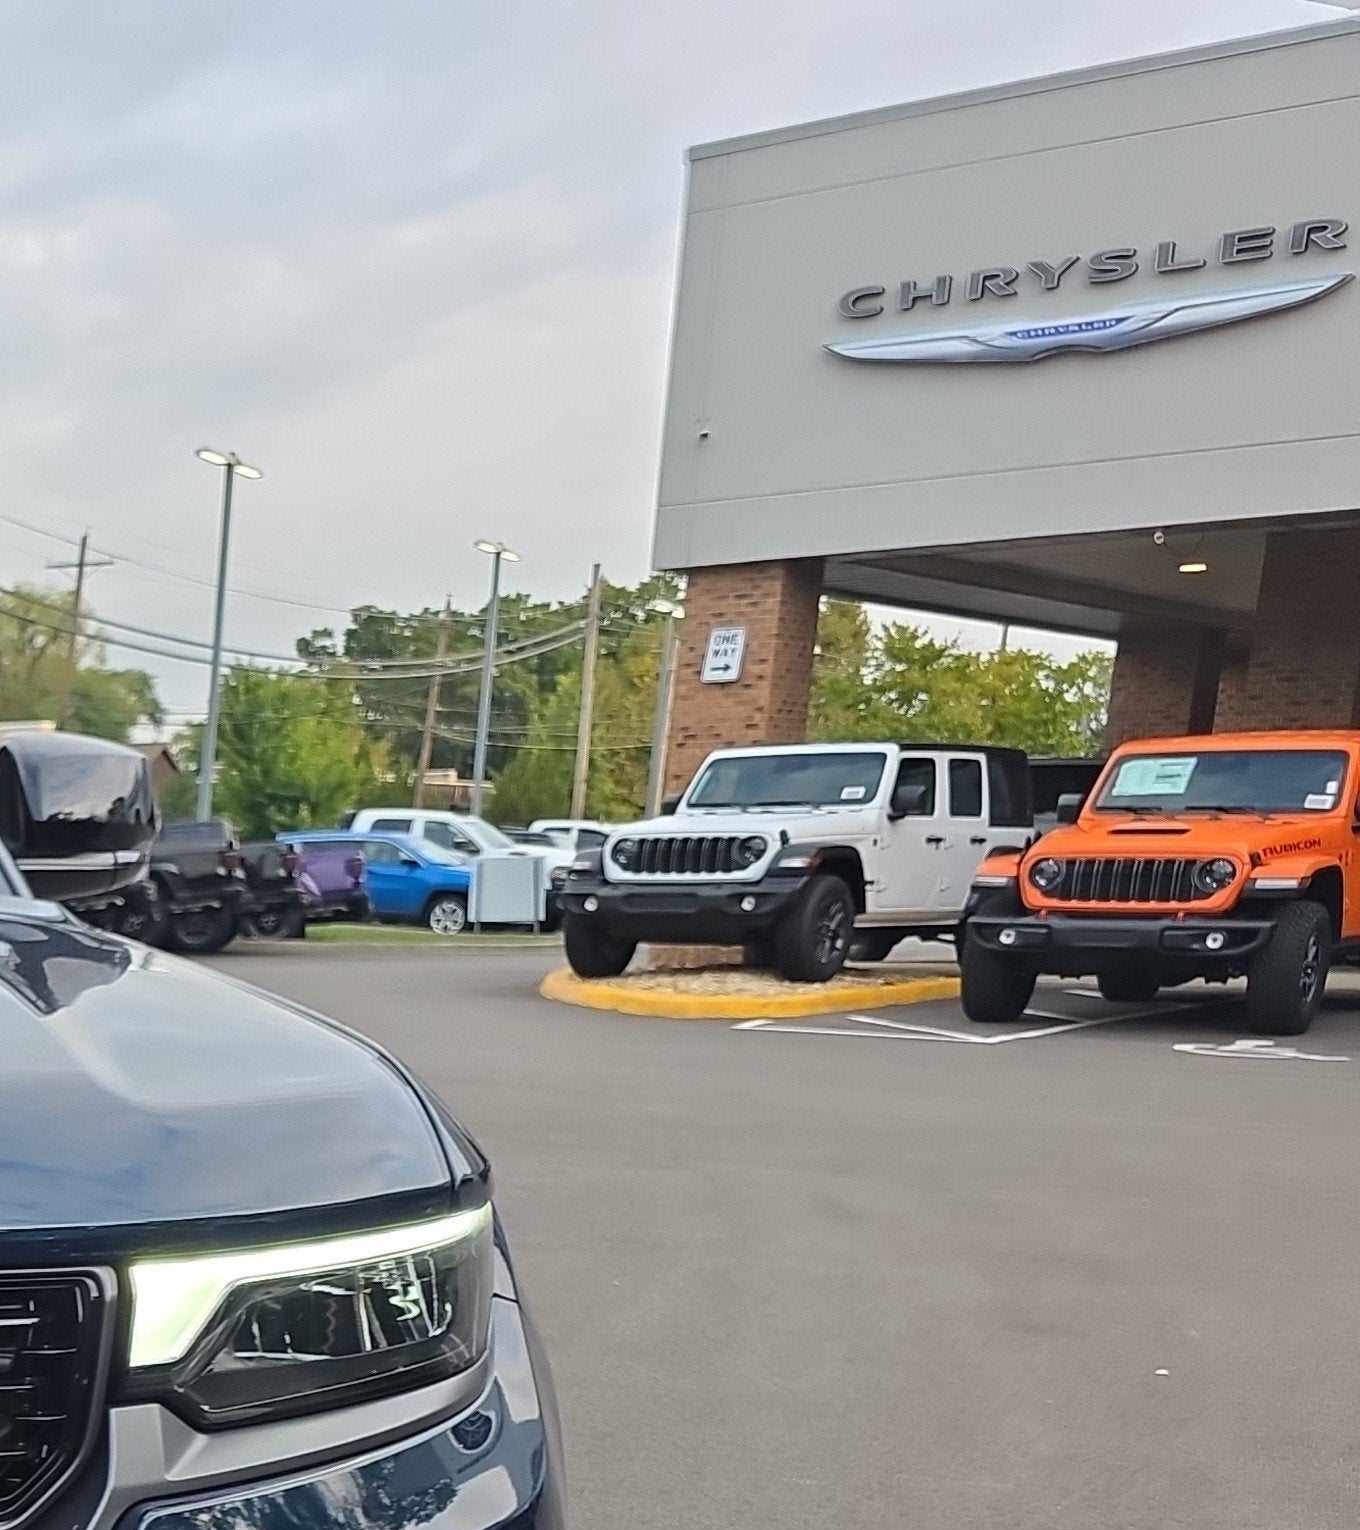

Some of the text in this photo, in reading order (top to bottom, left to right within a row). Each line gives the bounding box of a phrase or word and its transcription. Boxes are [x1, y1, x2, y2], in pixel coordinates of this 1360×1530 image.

[838, 218, 1349, 318] CHRYSLER
[713, 632, 739, 646] ONE
[711, 647, 737, 658] WAY
